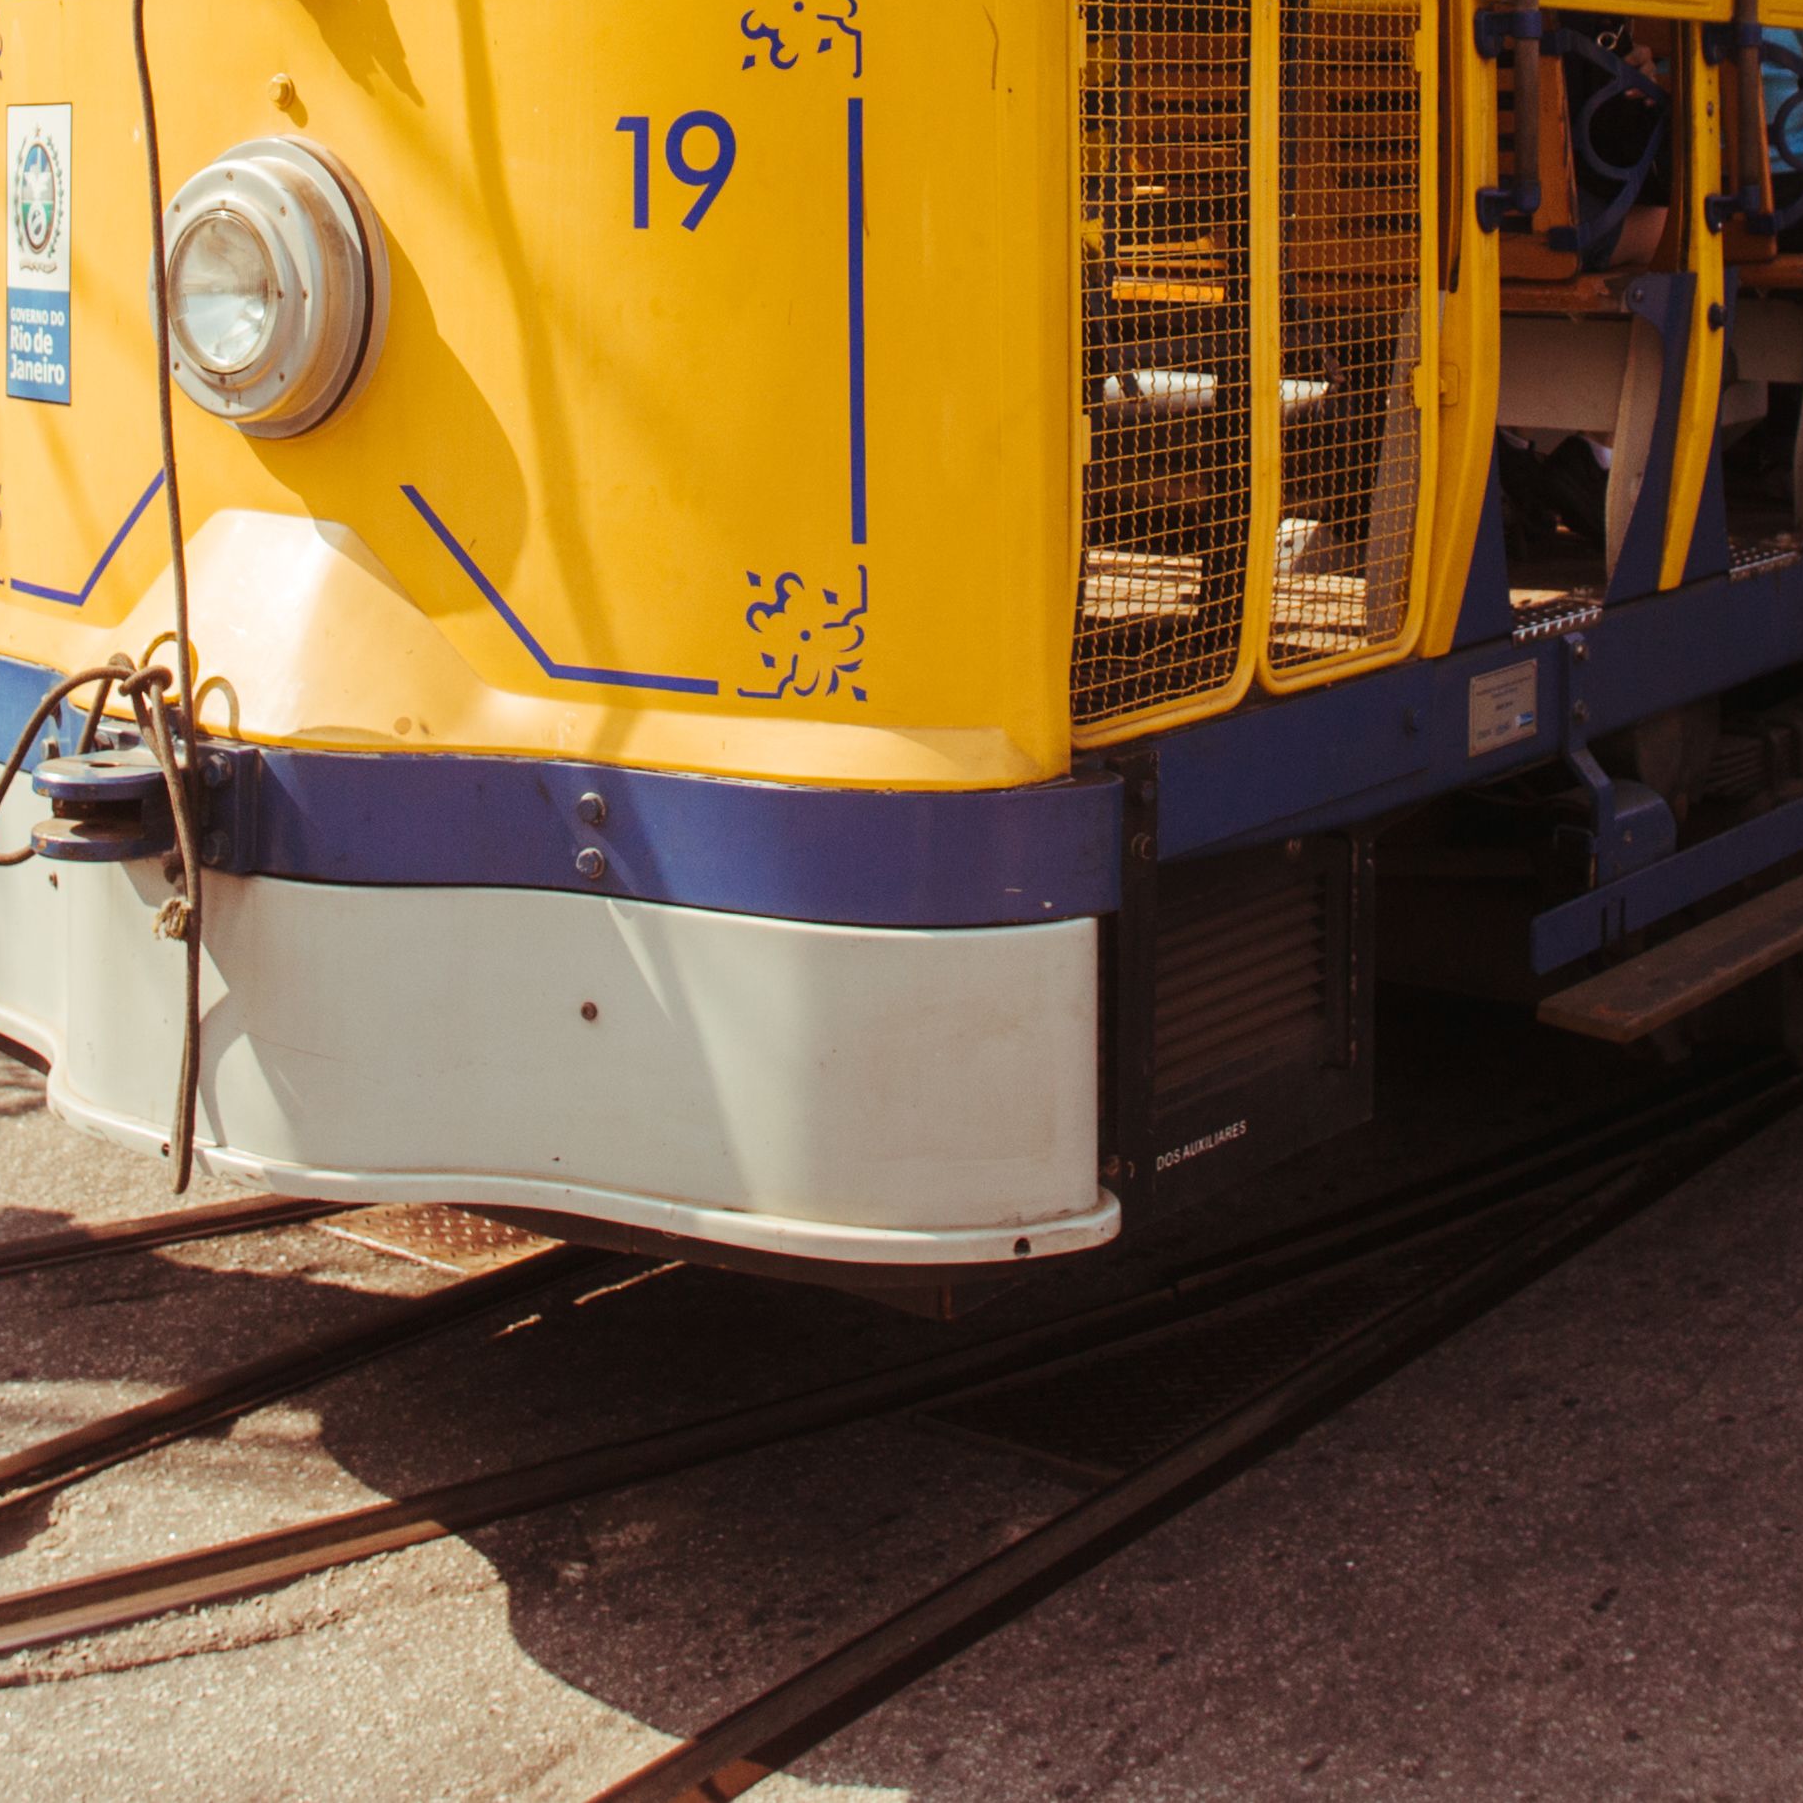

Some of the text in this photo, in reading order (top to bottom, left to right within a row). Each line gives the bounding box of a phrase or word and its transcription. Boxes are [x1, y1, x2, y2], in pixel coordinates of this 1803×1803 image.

[615, 110, 736, 232] 19
[10, 307, 65, 327] GOVERNO DO
[10, 324, 53, 355] Rio de
[10, 353, 66, 385] Janeiro
[1156, 1119, 1247, 1172] DOS AUXILIARES
